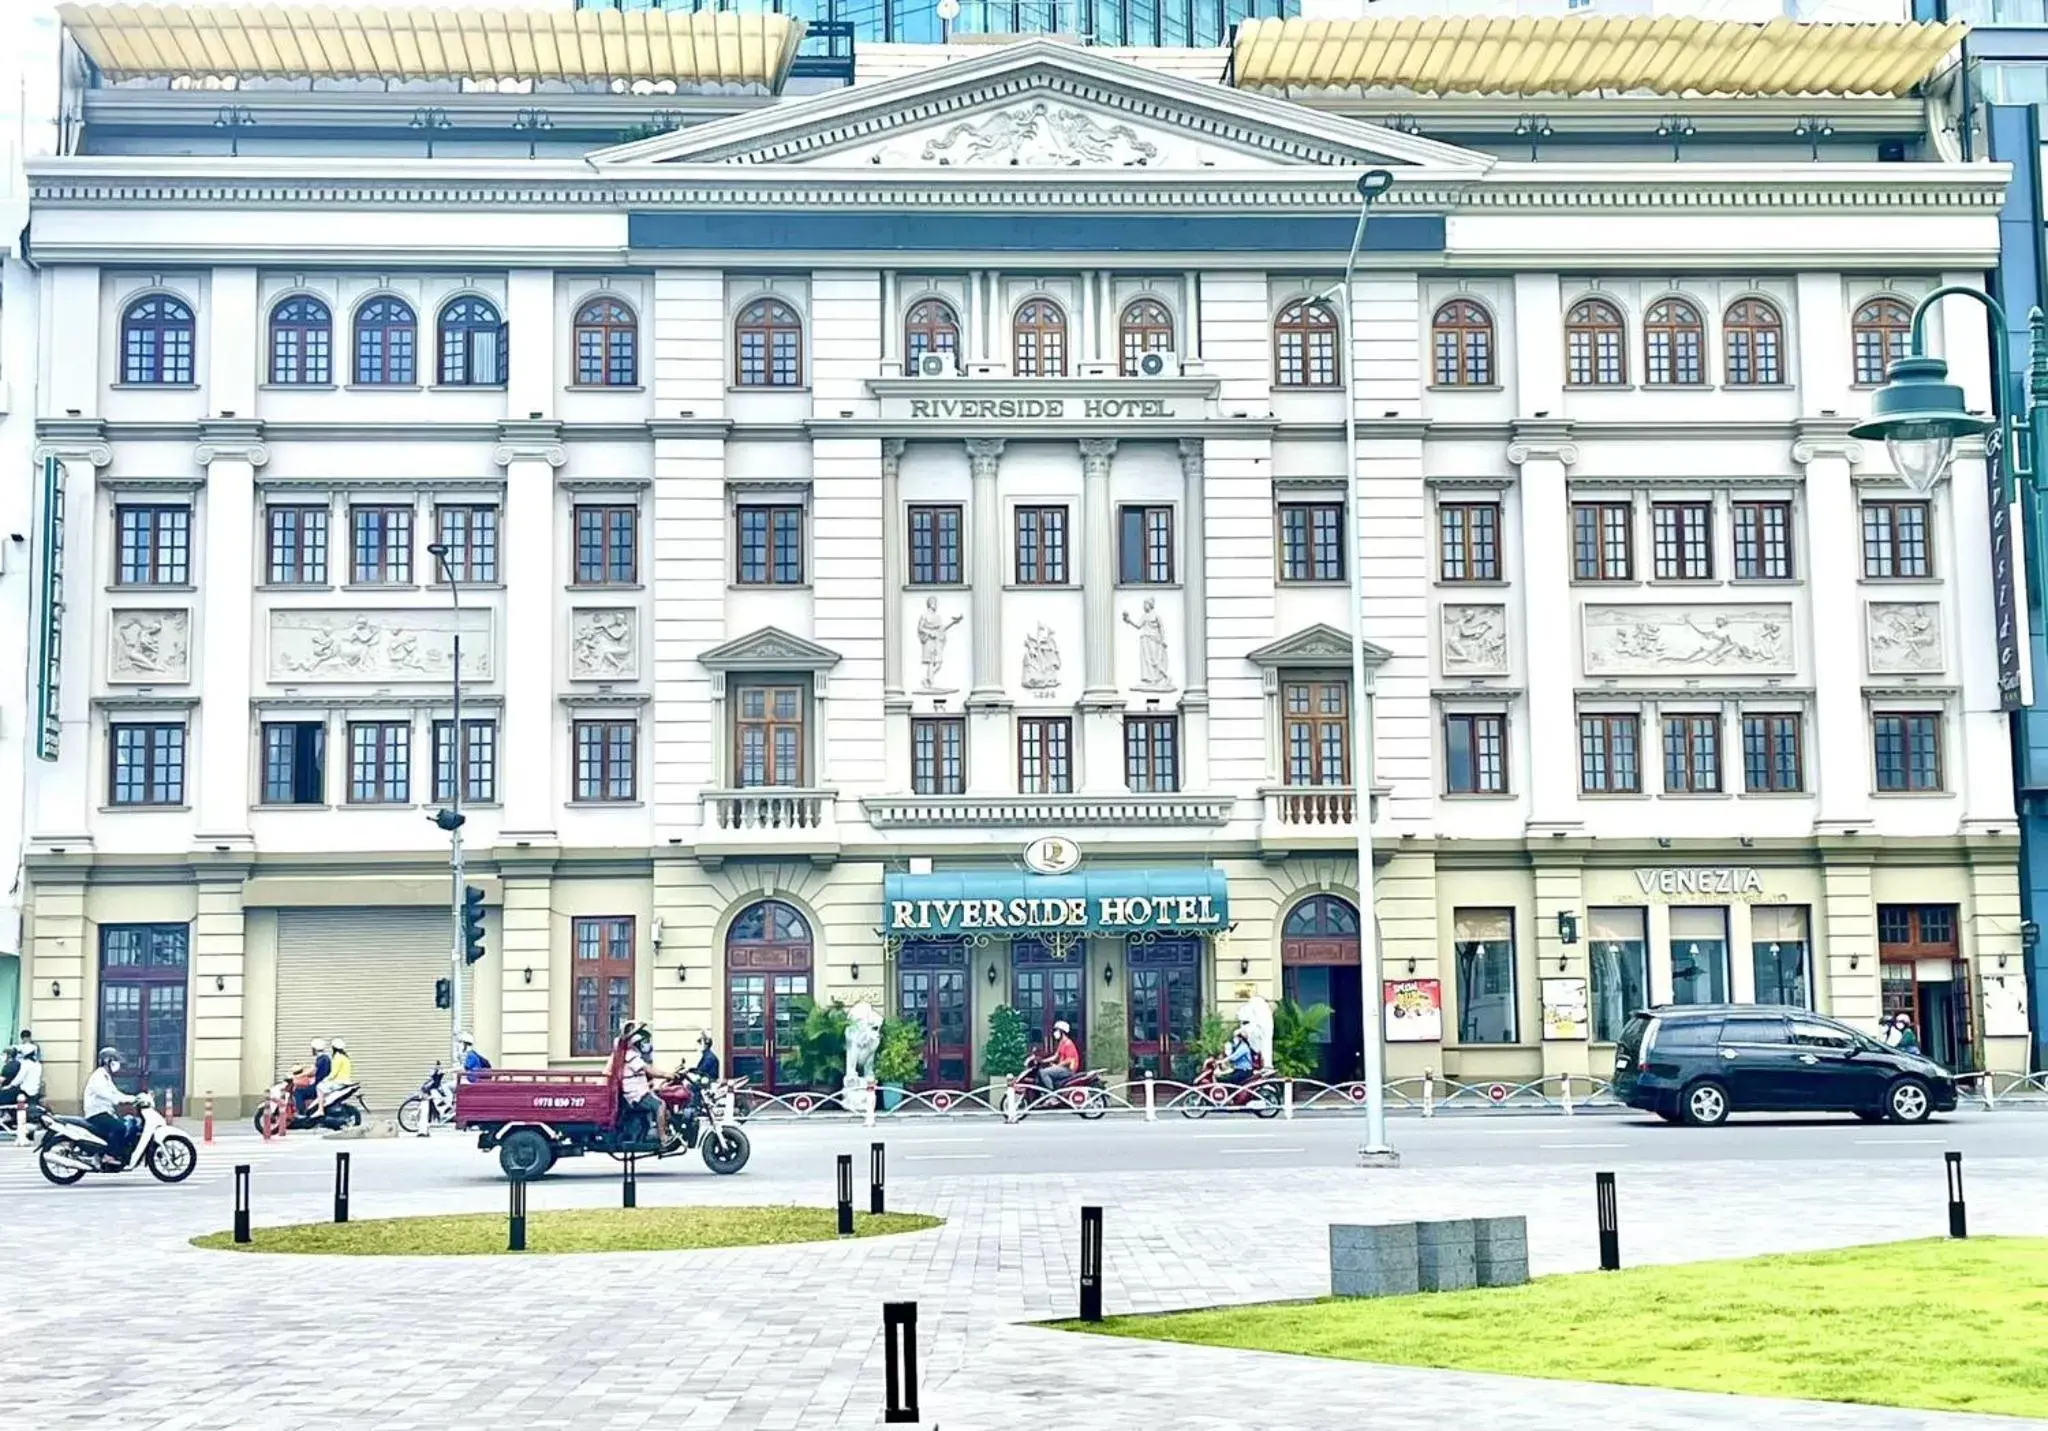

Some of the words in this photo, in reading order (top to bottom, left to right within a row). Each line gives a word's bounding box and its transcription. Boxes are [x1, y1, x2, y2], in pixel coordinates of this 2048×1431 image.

[911, 400, 1064, 418] RIVERSIDE
[1084, 400, 1175, 418] HOTEL
[1634, 868, 1763, 895] VENEZIA
[891, 898, 1088, 928] RIVERSIDE
[1098, 896, 1220, 924] HOTEL
